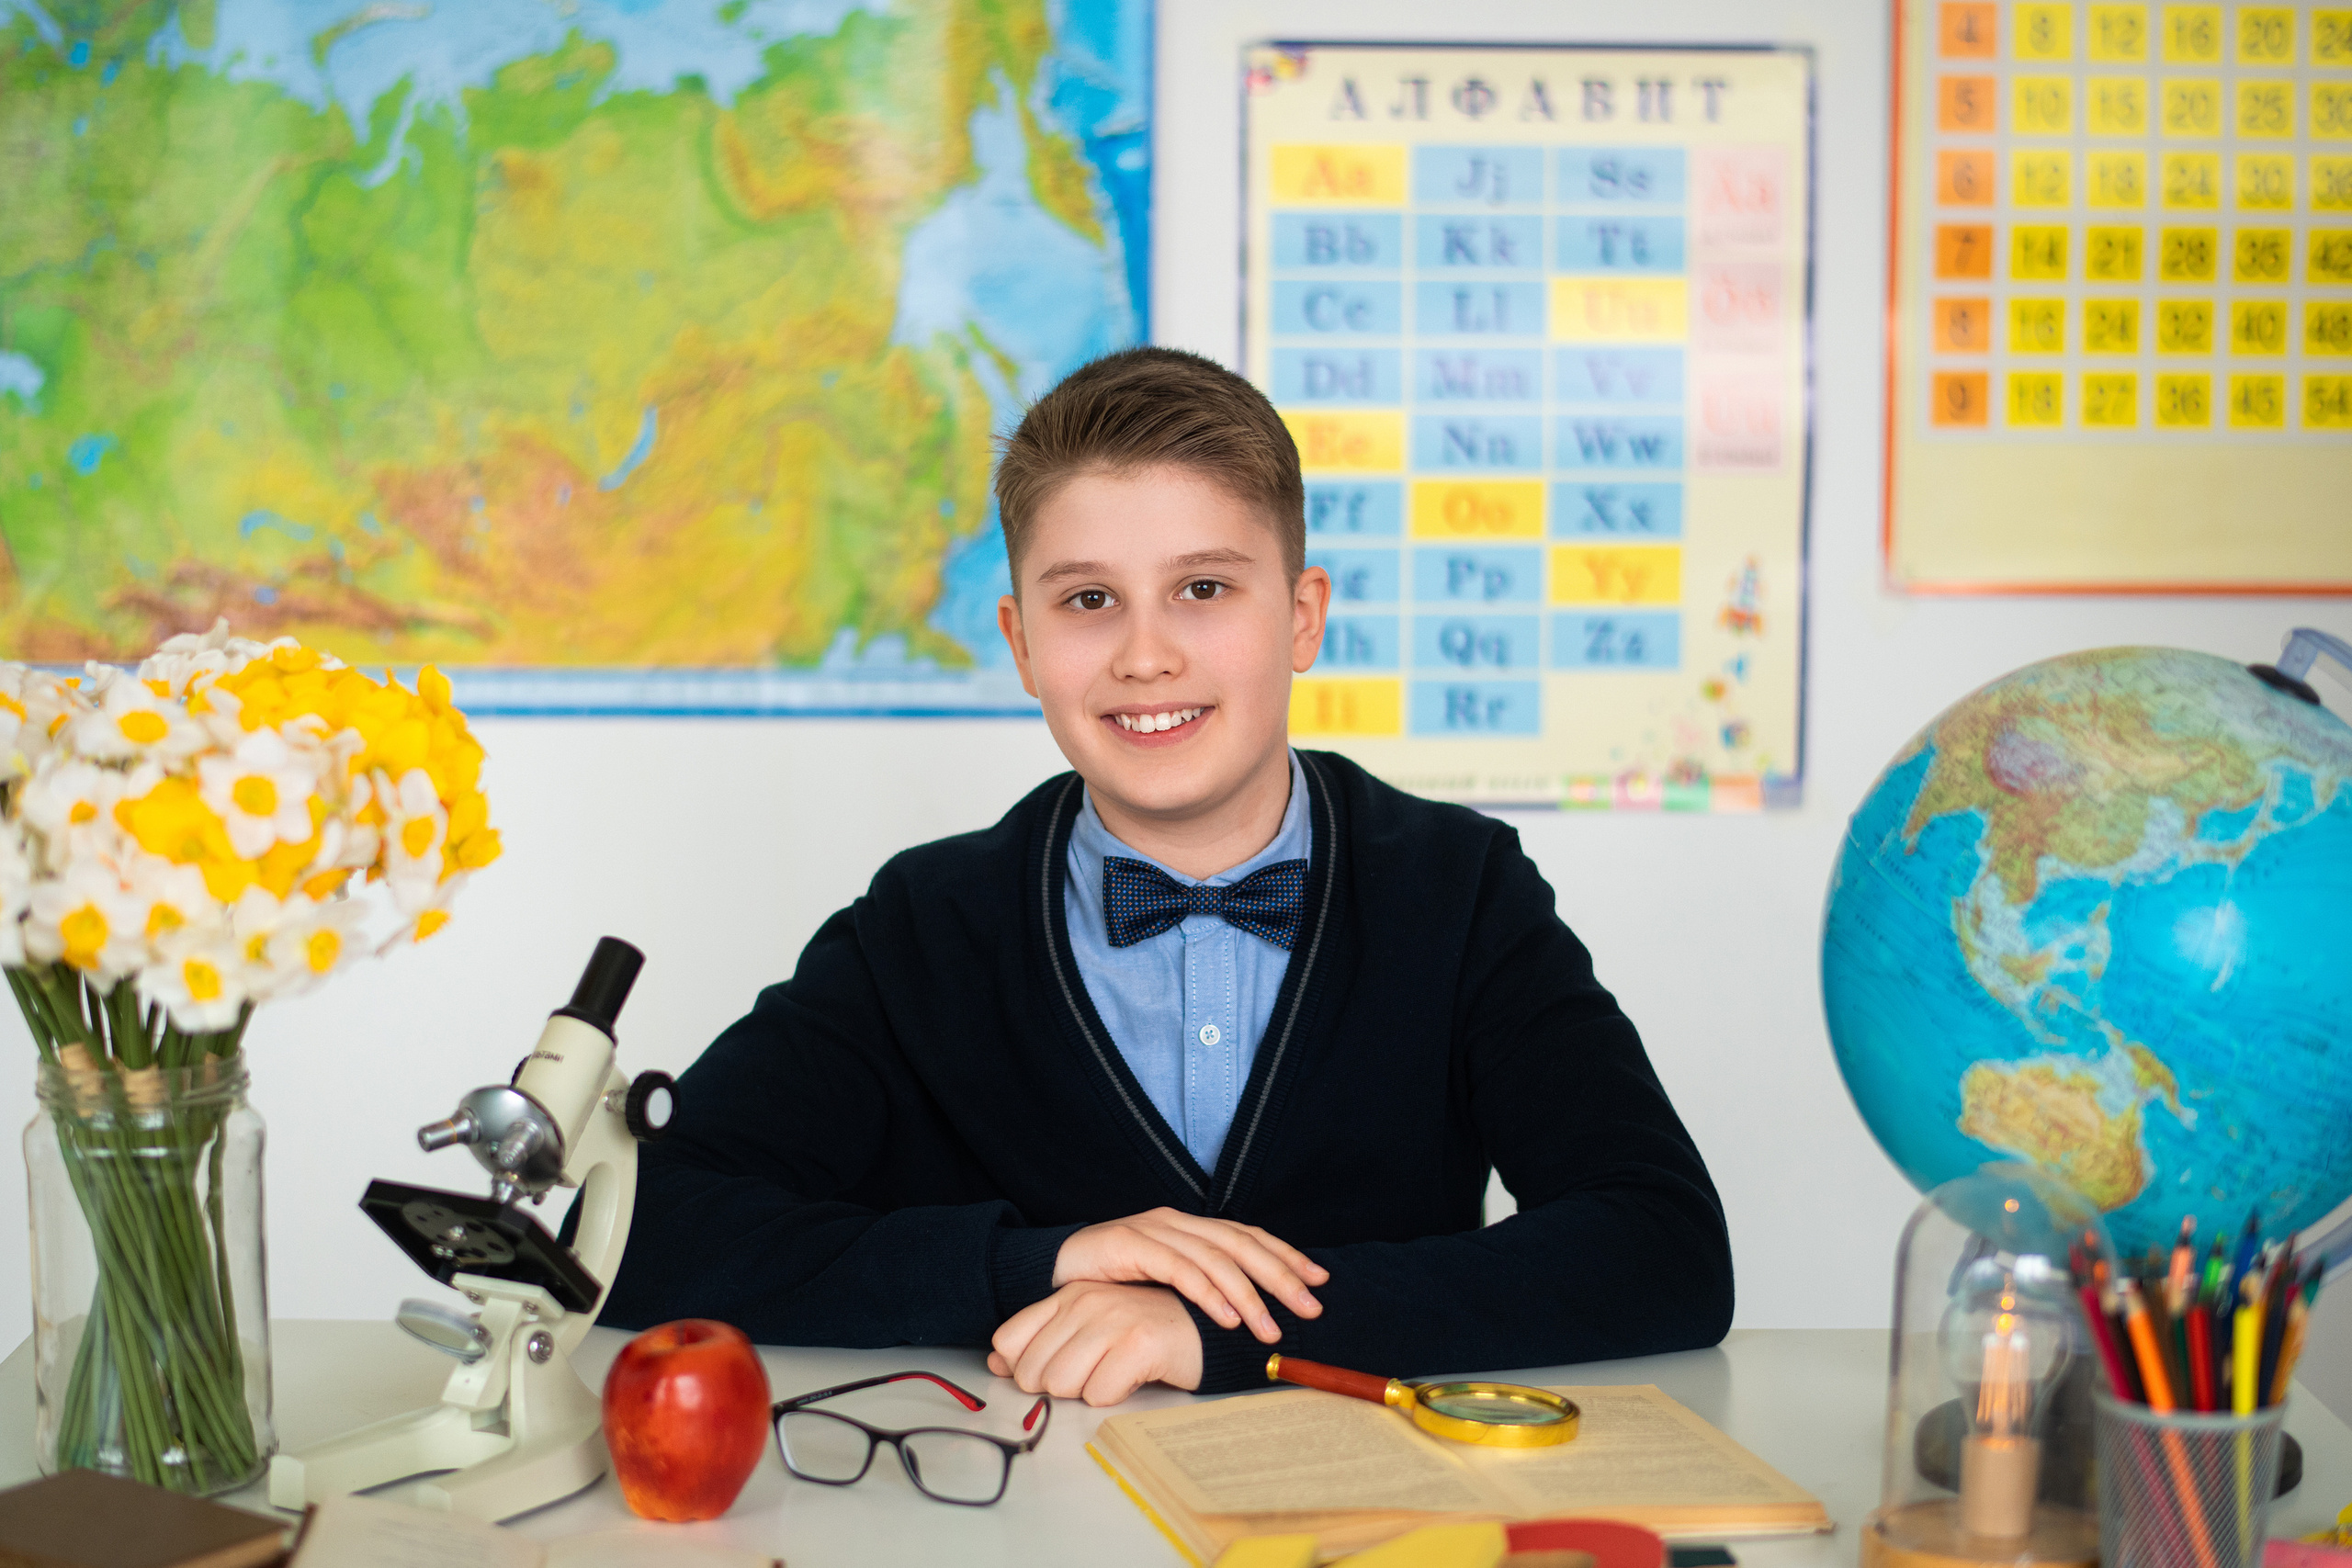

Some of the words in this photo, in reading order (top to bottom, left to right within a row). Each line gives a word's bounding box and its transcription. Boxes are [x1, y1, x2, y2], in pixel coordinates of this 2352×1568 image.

[1955, 7, 1980, 44] 4
[2029, 11, 2056, 54] 8
[2098, 12, 2143, 54] 12
[2174, 13, 2218, 56] 16
[2242, 13, 2289, 58] 20
[1329, 75, 1732, 125] АЛФАВИТ
[1953, 80, 1980, 125] 5
[2024, 85, 2063, 130] 10
[2098, 85, 2142, 129] 15
[2165, 86, 2215, 130] 20
[2241, 87, 2289, 132] 25
[1305, 154, 1375, 199] Aa
[1455, 154, 1510, 207] Jj
[1589, 156, 1654, 201] Ss
[1952, 157, 1979, 200] 6
[2024, 160, 2063, 202] 12
[2098, 161, 2141, 202] 18
[2165, 160, 2212, 202] 24
[2240, 162, 2288, 205] 30
[1303, 222, 1378, 266] Bb
[1443, 223, 1518, 266] Kk
[1587, 222, 1651, 267] Tt
[1953, 230, 1978, 272] 7
[2021, 231, 2062, 268] 14
[2092, 231, 2134, 272] 21
[2163, 231, 2213, 276] 28
[2238, 232, 2287, 276] 35
[1302, 288, 1372, 333] Cc
[1451, 289, 1511, 334] Ll
[1583, 286, 1661, 334] Uu
[1948, 304, 1973, 348] 8
[2018, 307, 2056, 351] 16
[2086, 307, 2132, 349] 24
[2158, 307, 2207, 351] 32
[2233, 309, 2282, 351] 40
[2306, 310, 2352, 352] 48
[1303, 357, 1374, 400] Dd
[1434, 357, 1531, 400] Mm
[1585, 356, 1655, 400] Vv
[1946, 378, 1970, 422] 9
[2016, 380, 2056, 423] 18
[2084, 380, 2132, 422] 27
[2158, 382, 2206, 423] 36
[2233, 382, 2280, 423] 45
[2305, 383, 2352, 423] 54
[1305, 420, 1374, 466] Ee
[1443, 421, 1518, 466] Nn
[1574, 422, 1668, 464] Ww
[1307, 489, 1368, 534] Ff
[1441, 487, 1517, 535] Oo
[1581, 489, 1654, 533] Xx
[1443, 557, 1510, 602] Pp
[1585, 555, 1650, 604] Yy
[1439, 622, 1512, 668] Qq
[1312, 686, 1360, 731] Ii
[1443, 688, 1507, 731] Rr
